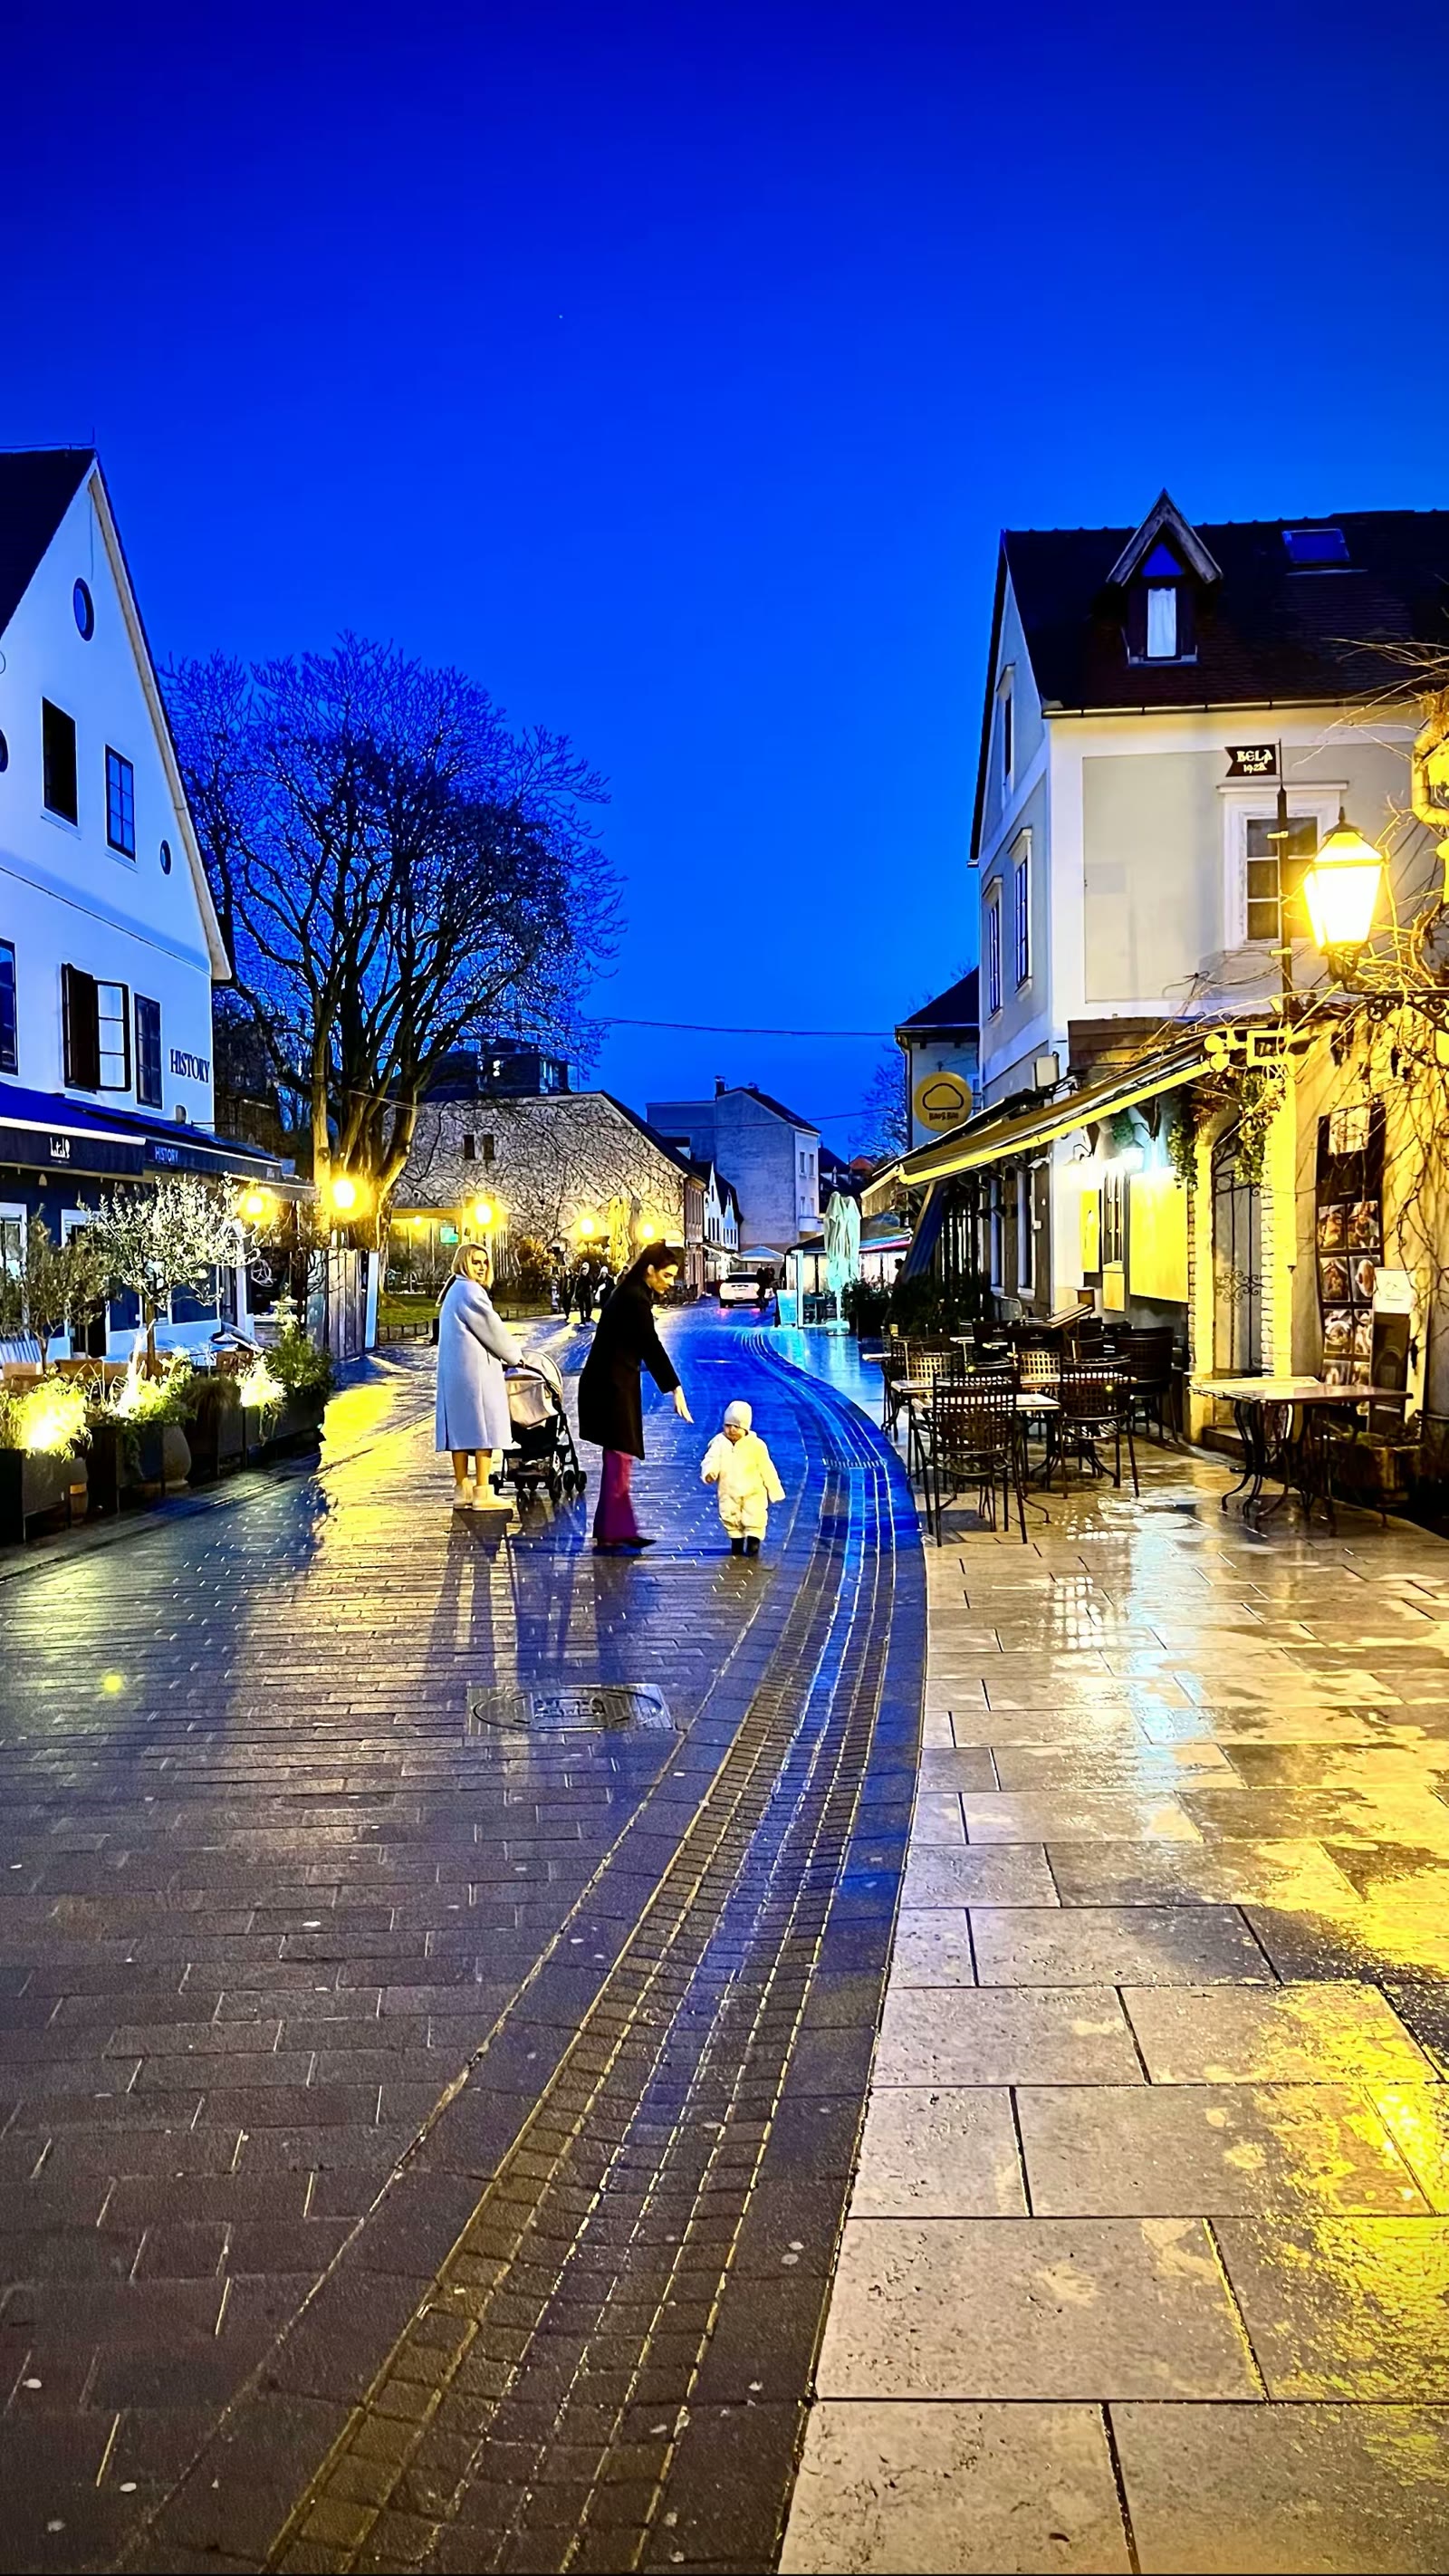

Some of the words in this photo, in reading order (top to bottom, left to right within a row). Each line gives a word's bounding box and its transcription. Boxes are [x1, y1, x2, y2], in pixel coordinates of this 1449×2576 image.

[1236, 749, 1273, 764] BELA
[170, 1048, 210, 1083] HISTORY
[154, 1146, 178, 1163] HISTORY
